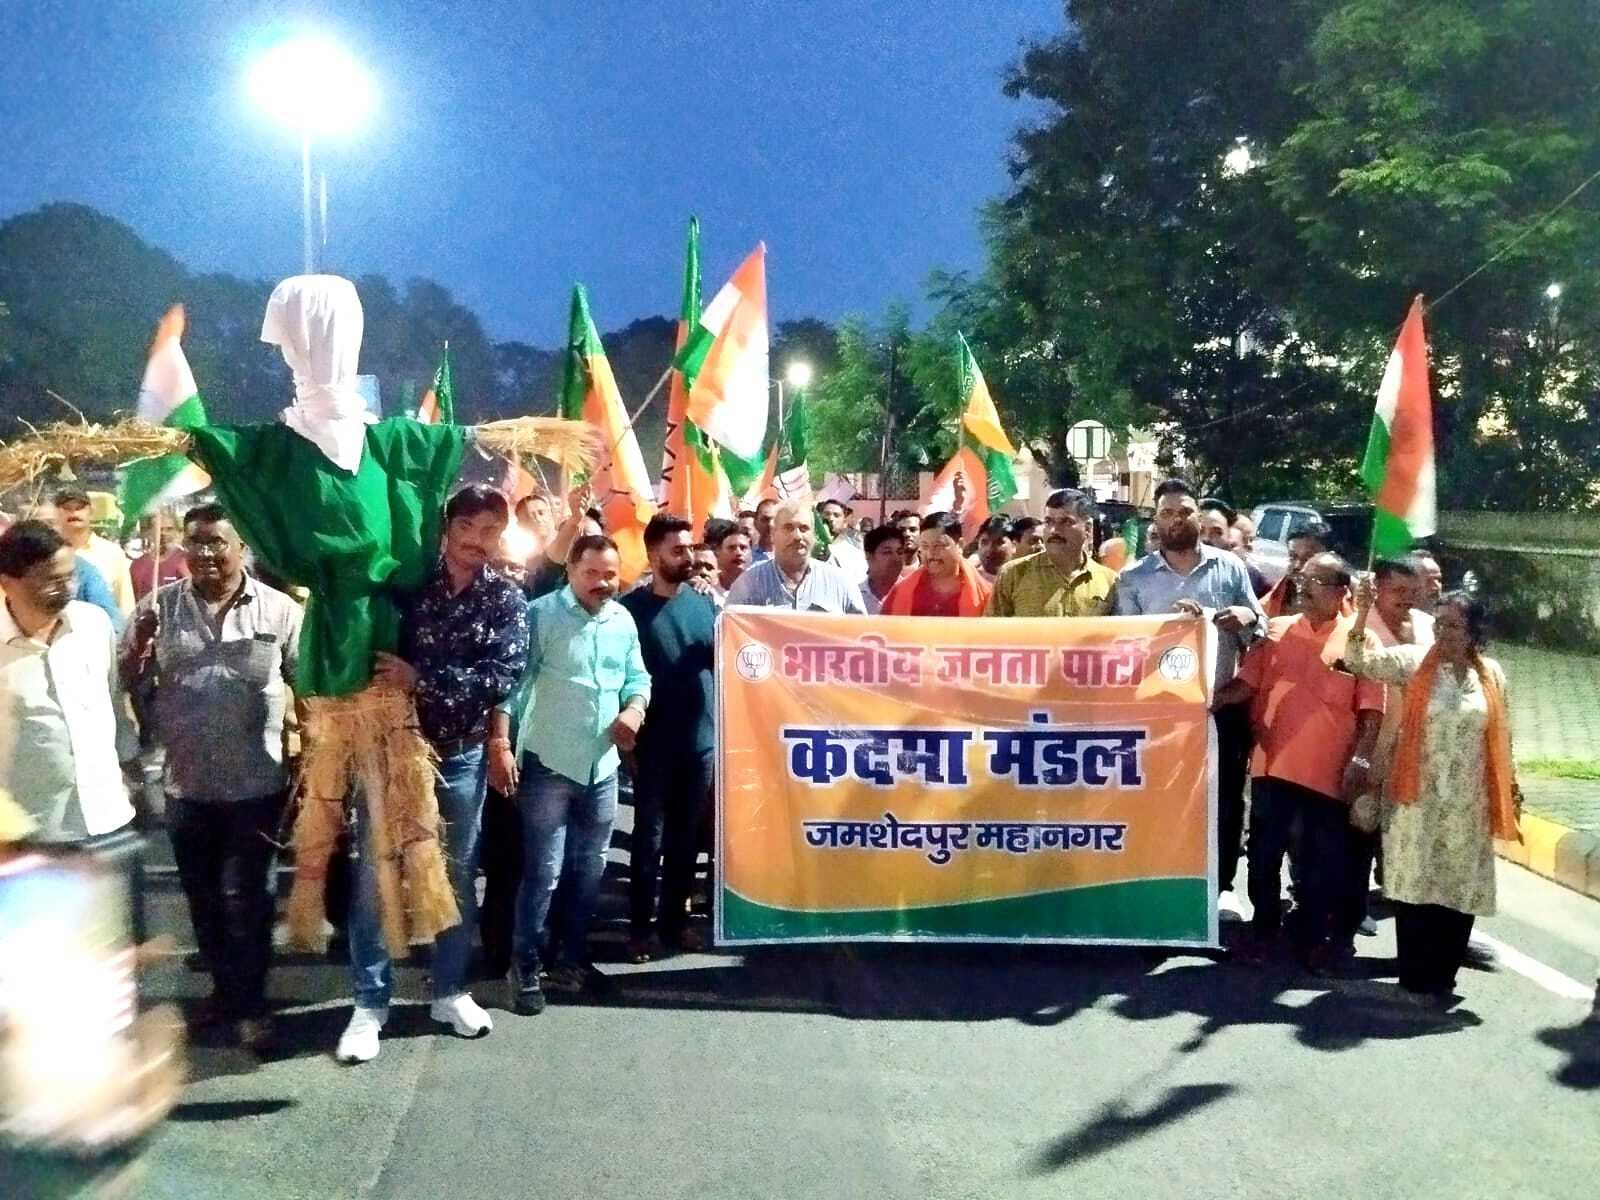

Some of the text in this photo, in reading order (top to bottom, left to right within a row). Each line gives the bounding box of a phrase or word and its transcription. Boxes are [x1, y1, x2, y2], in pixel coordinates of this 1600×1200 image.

[935, 648, 1050, 685] जनता
[784, 713, 1145, 785] कदमा मंडल
[803, 812, 1127, 864] जमशेदपुर महानगर
